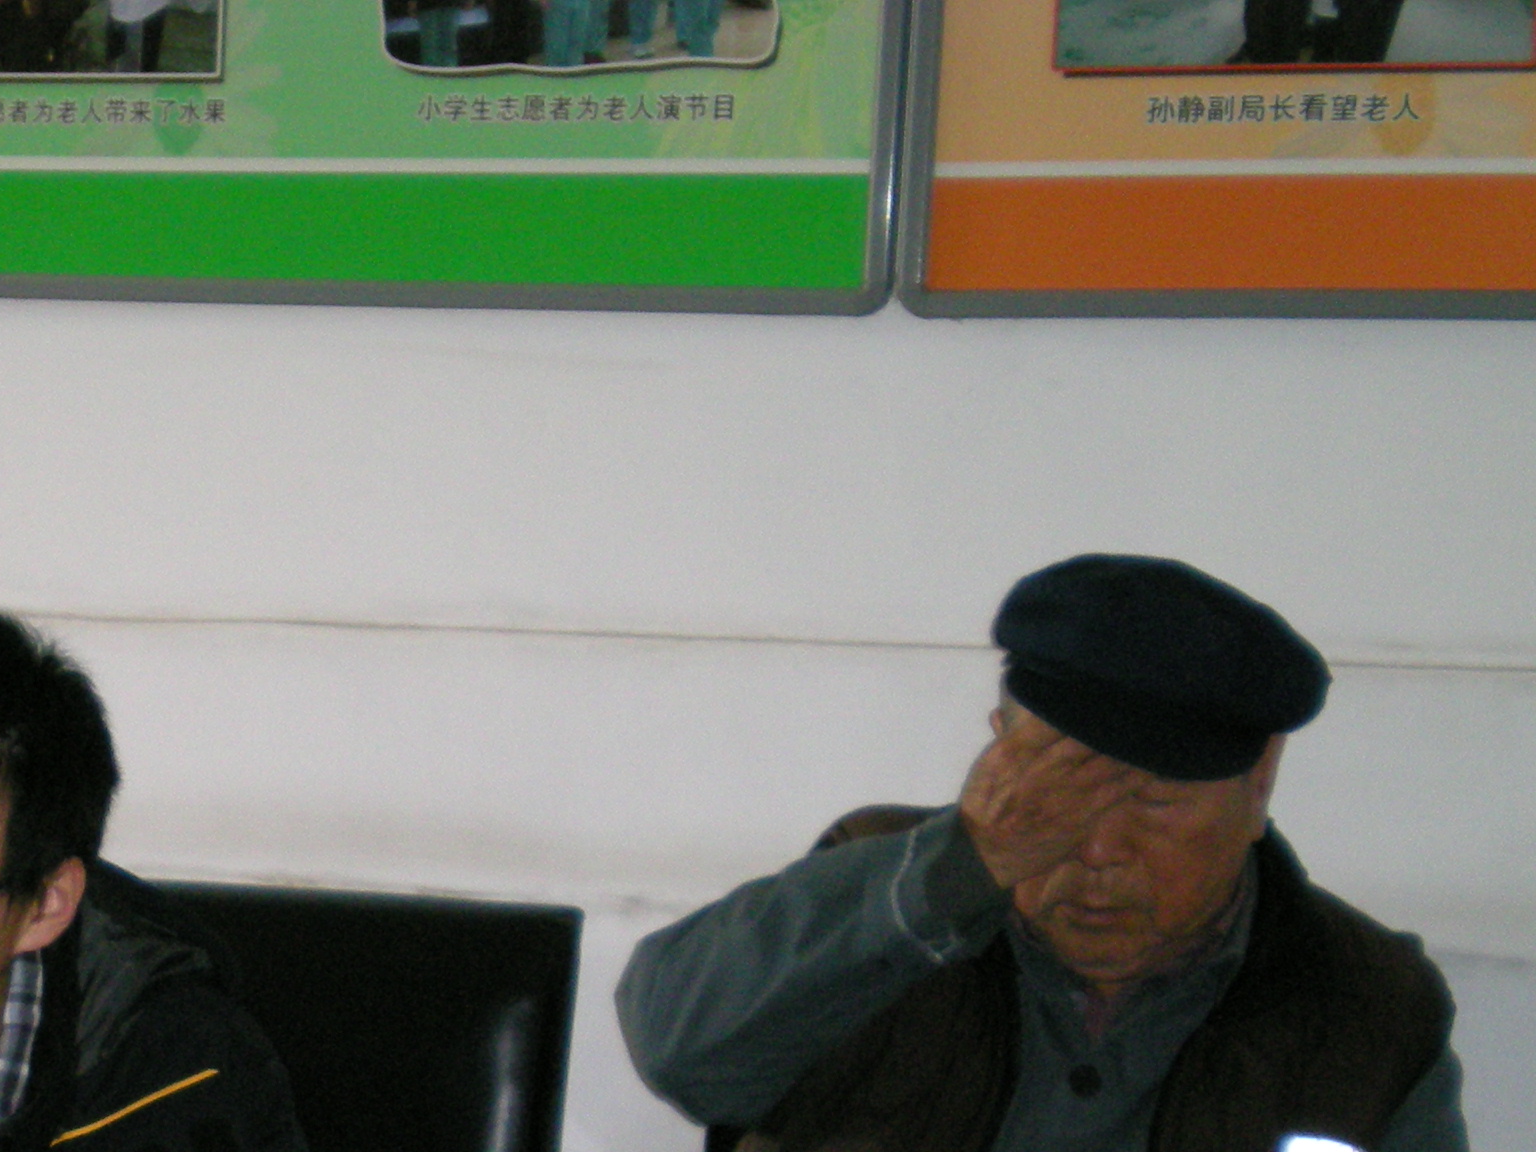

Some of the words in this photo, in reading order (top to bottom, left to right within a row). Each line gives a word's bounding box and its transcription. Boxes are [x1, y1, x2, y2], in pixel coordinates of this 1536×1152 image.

[418, 94, 735, 121] 小学生志愿者为老人演节目
[1146, 93, 1419, 123] 孙静副局长看望老人
